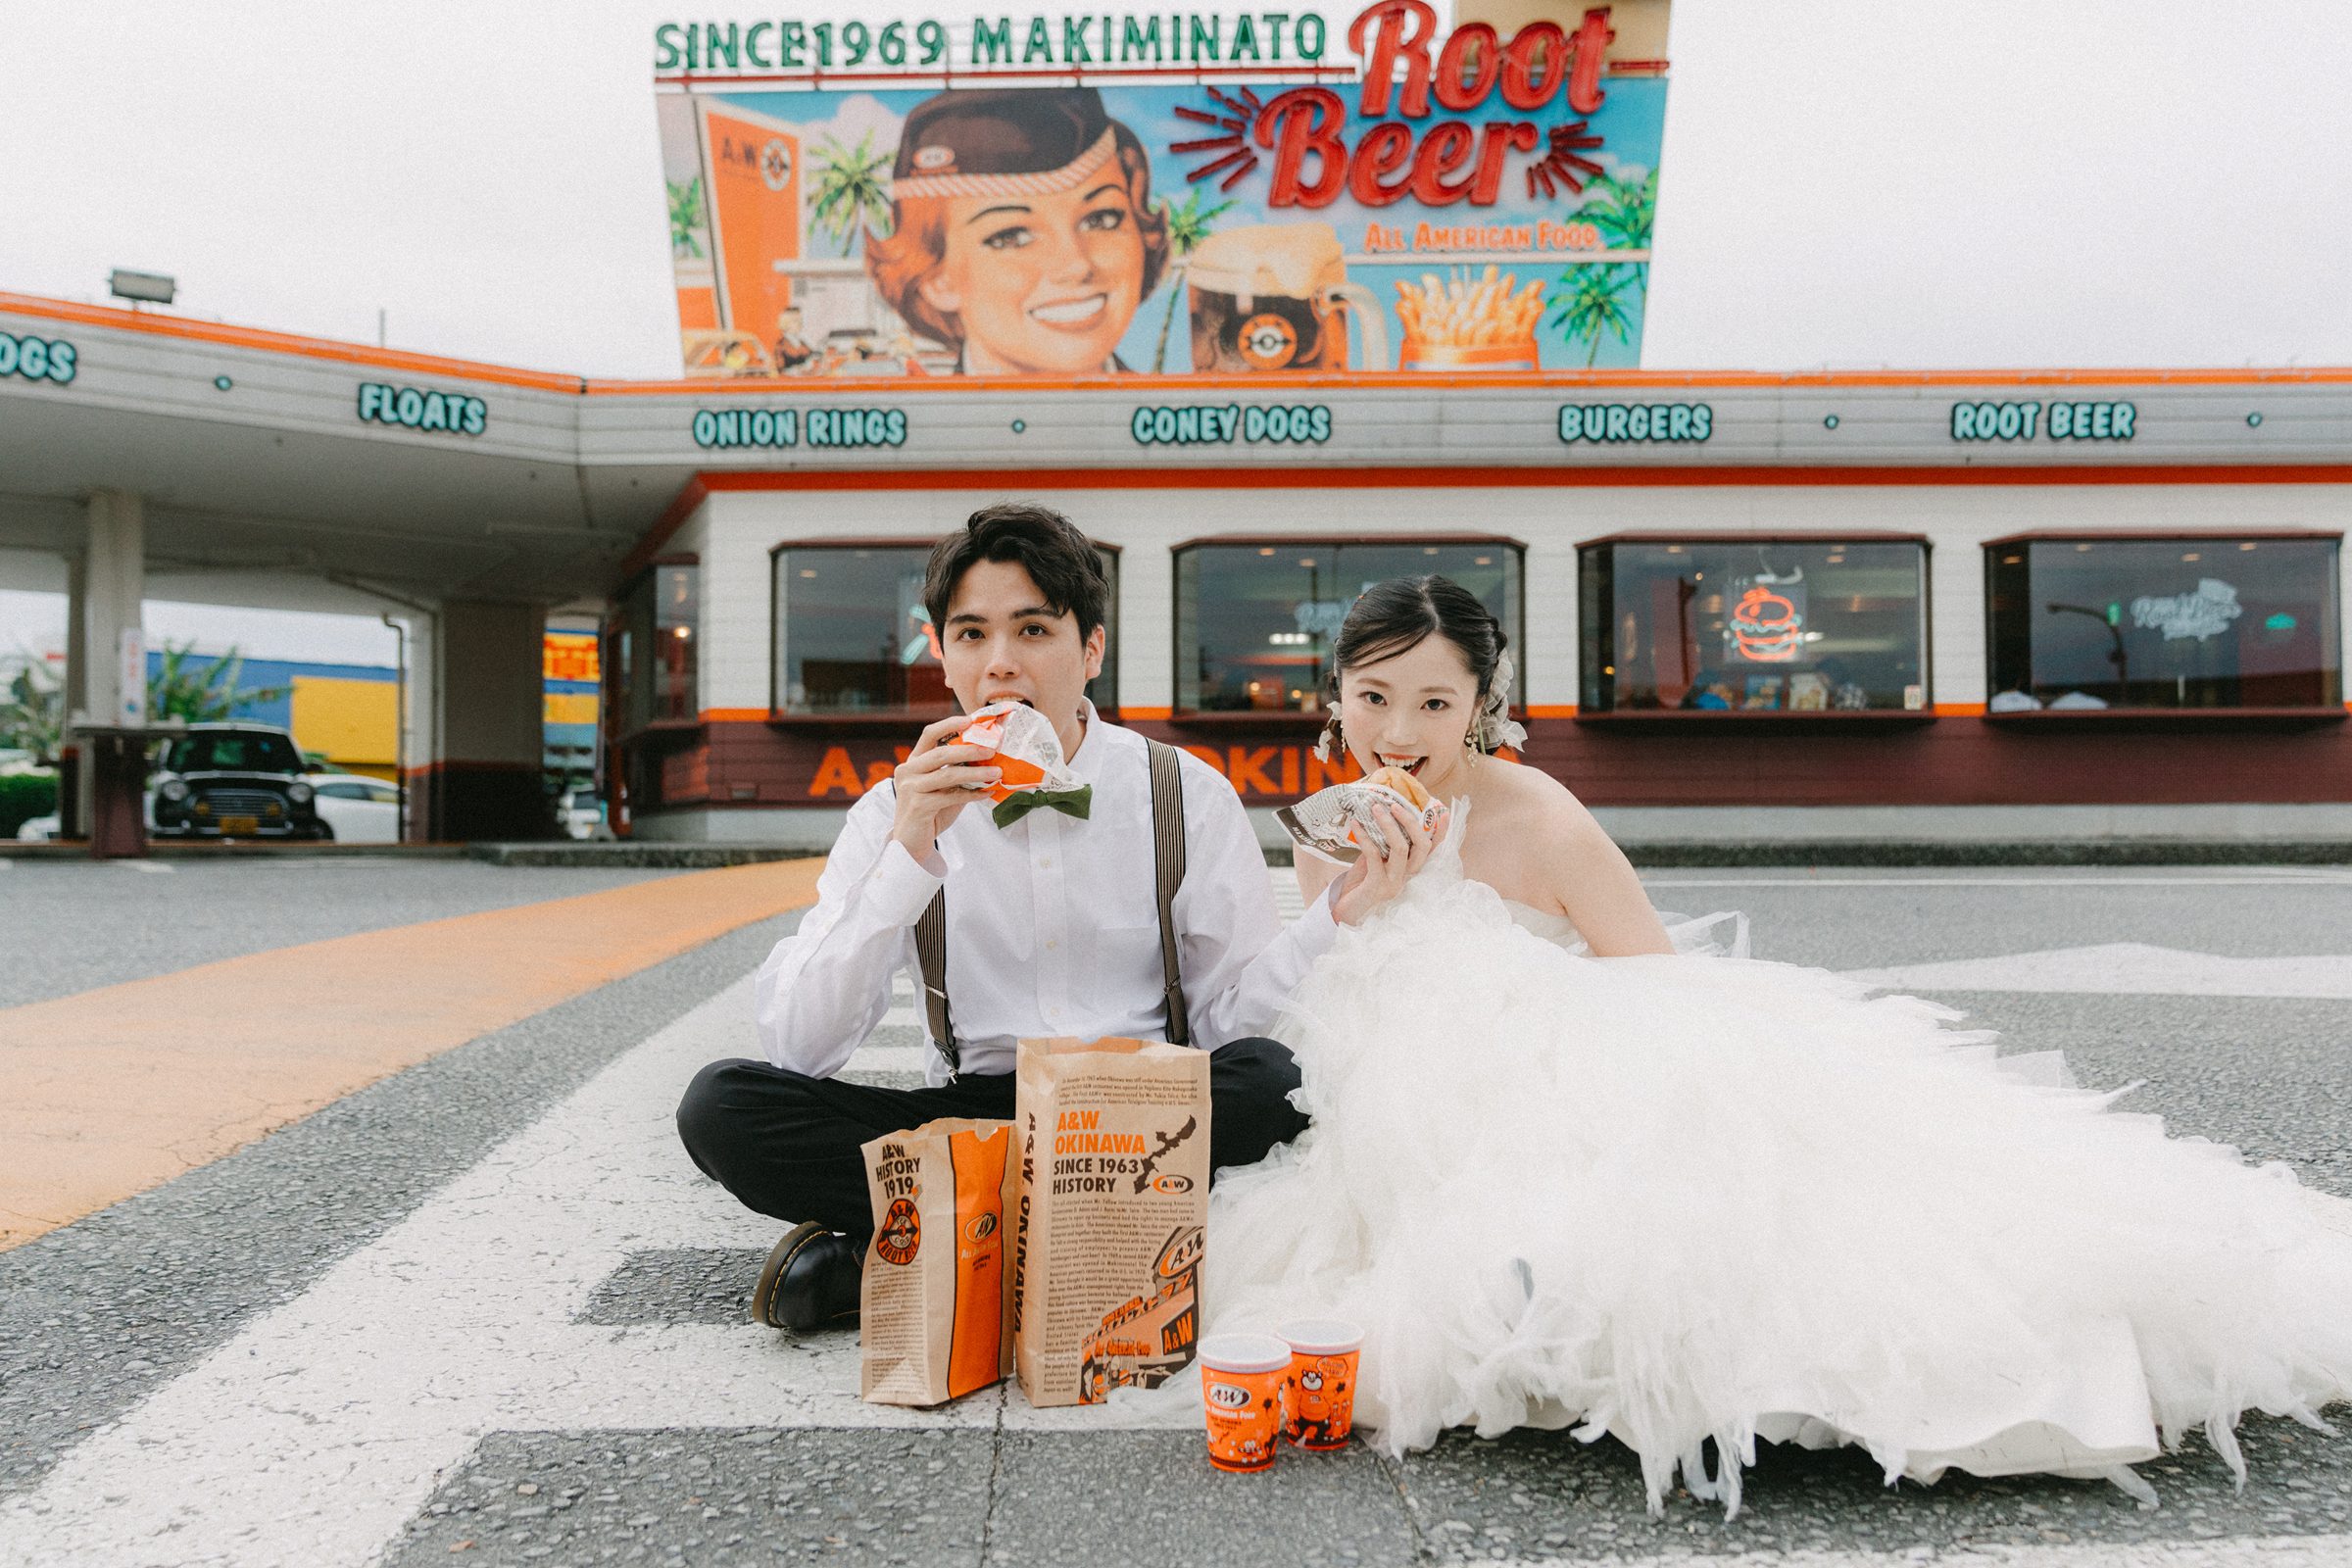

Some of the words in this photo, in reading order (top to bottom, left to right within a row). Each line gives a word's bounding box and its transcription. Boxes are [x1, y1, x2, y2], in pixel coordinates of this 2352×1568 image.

[972, 13, 1326, 66] MAKIMINATO
[1348, 0, 1615, 118] Root
[1253, 86, 1539, 208] Beer
[1364, 221, 1405, 251] ALL
[1414, 221, 1532, 251] AMERICAN
[359, 382, 487, 435] FLOATS
[1132, 403, 1240, 445] CONEY
[1245, 405, 1331, 444] DOGS
[1559, 403, 1713, 443] BURGERS
[1952, 402, 2040, 440] ROOT
[2048, 402, 2135, 440] BEER
[693, 410, 798, 448] ONION
[807, 409, 906, 447] RINGS
[808, 746, 912, 797] A&
[1056, 1110, 1100, 1132] A&W
[882, 1144, 906, 1161] A&W
[1054, 1133, 1146, 1154] OKINAWA
[875, 1157, 920, 1182] HISTORY
[1054, 1158, 1093, 1175] SINCE
[1099, 1157, 1139, 1174] 1963
[884, 1176, 913, 1199] 1919
[1053, 1177, 1117, 1195] HISTORY
[1014, 1195, 1031, 1334] OKINAWA
[1163, 1311, 1194, 1354] A&W
